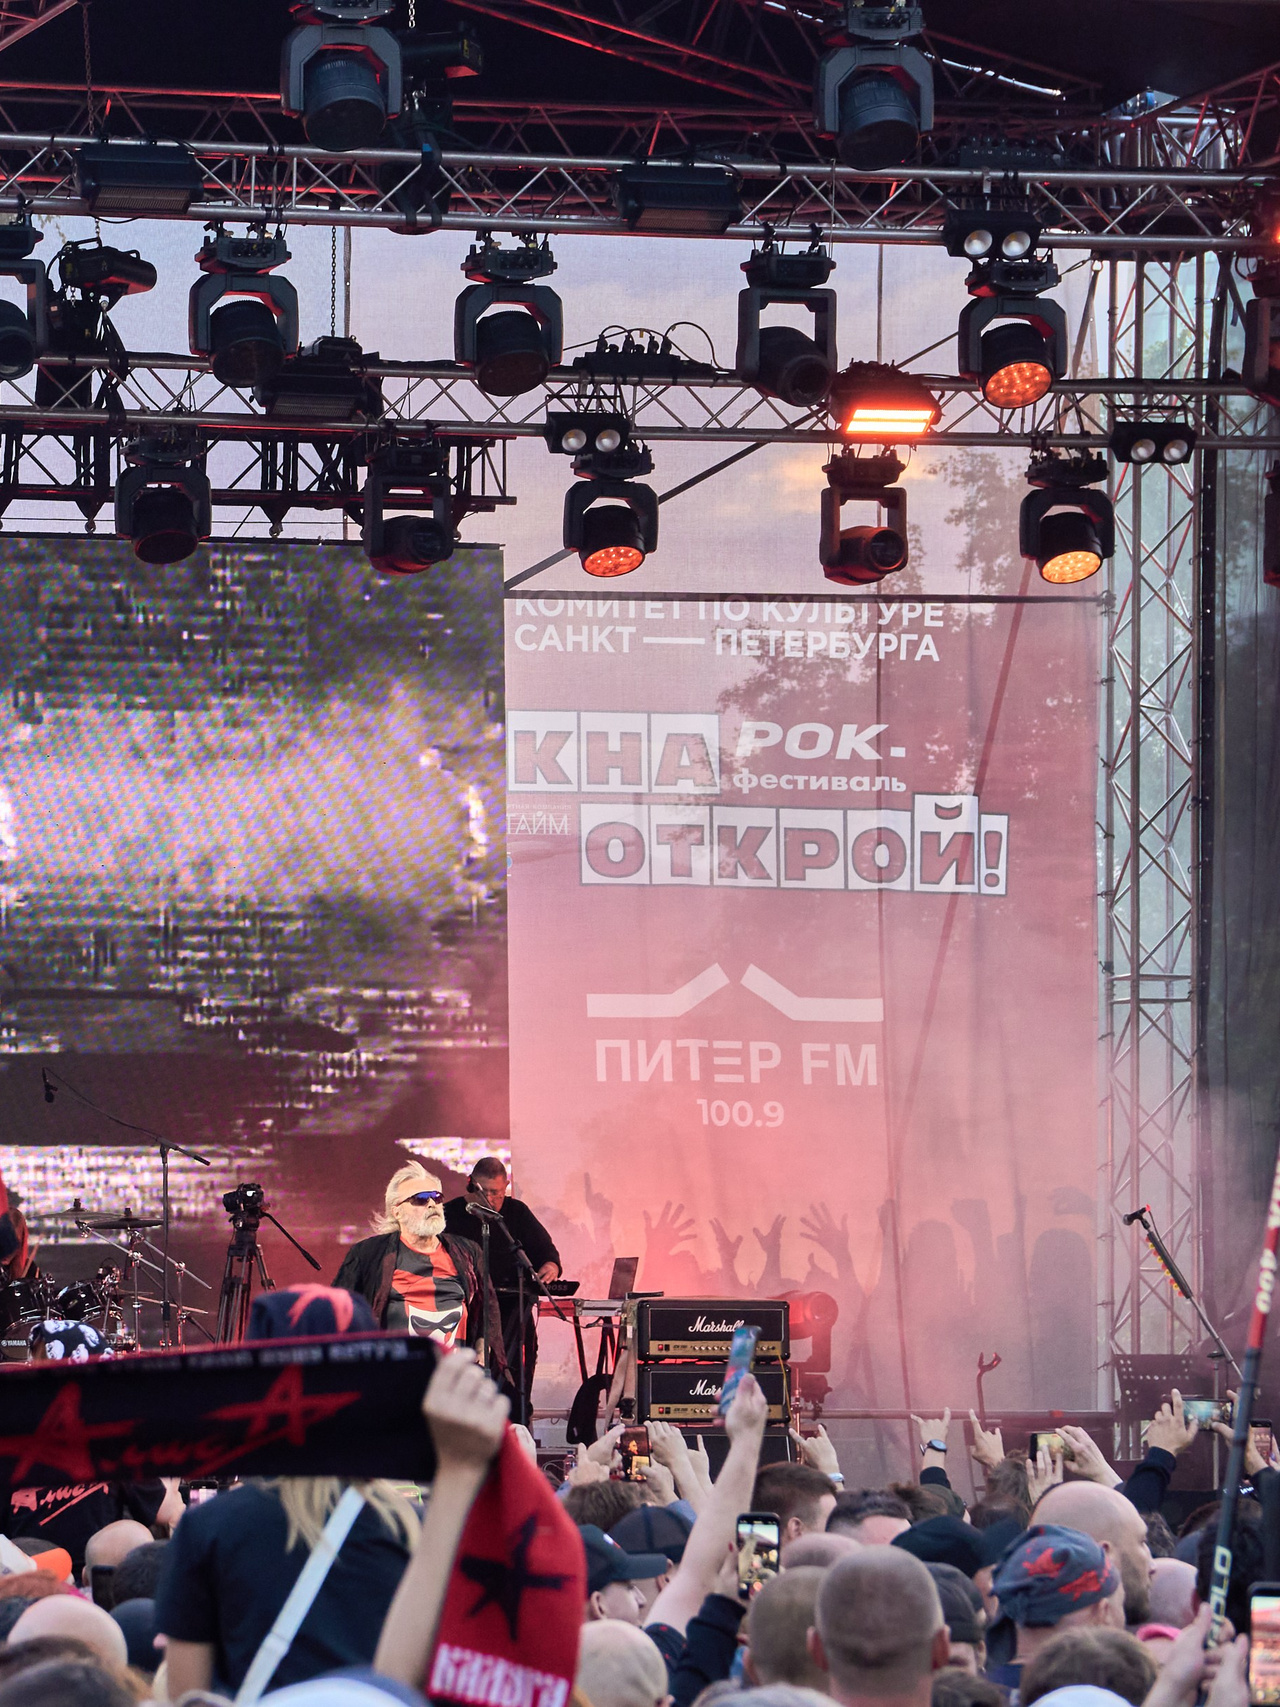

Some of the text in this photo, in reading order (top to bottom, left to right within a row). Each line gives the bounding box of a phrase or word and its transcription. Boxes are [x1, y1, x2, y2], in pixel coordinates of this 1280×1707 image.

[515, 596, 945, 627] КОМИТЕТ ПО КУЛЬТУРЕ
[732, 768, 907, 794] фестиваль
[584, 801, 1002, 890] ОТКРОЙ!
[596, 1038, 879, 1086] ПИТЕР FM
[696, 1097, 785, 1128] 100.9
[688, 1315, 745, 1333] Marshall
